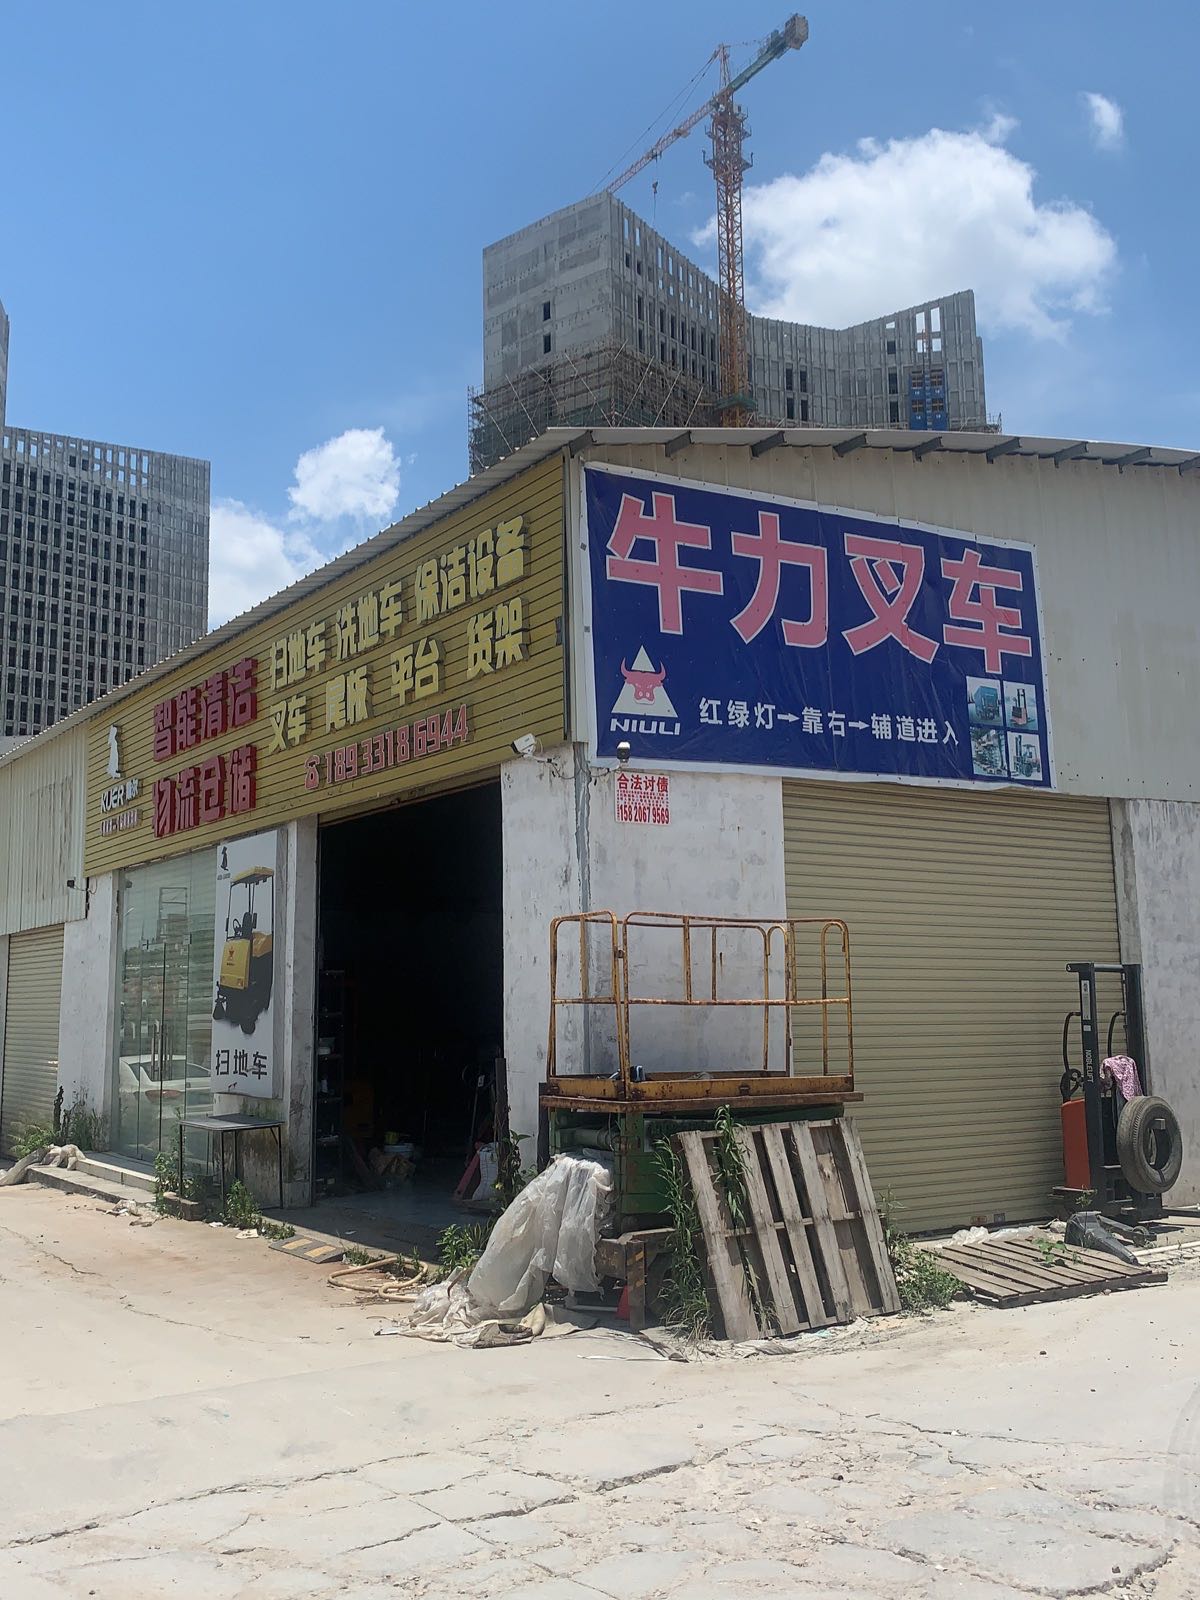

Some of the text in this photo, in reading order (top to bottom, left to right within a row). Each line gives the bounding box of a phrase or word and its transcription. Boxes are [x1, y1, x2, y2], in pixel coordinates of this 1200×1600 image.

[269, 515, 525, 691] 扫地车 洗地车 保洁设备
[605, 491, 1033, 674] 牛力叉车
[153, 658, 258, 761] 智能清洁
[269, 597, 523, 753] 叉车 尾板 平台 货架
[610, 718, 681, 736] NIULI
[151, 744, 257, 838] 物流仓储
[616, 772, 669, 793] 合法讨债
[215, 1049, 268, 1080] 扫地车
